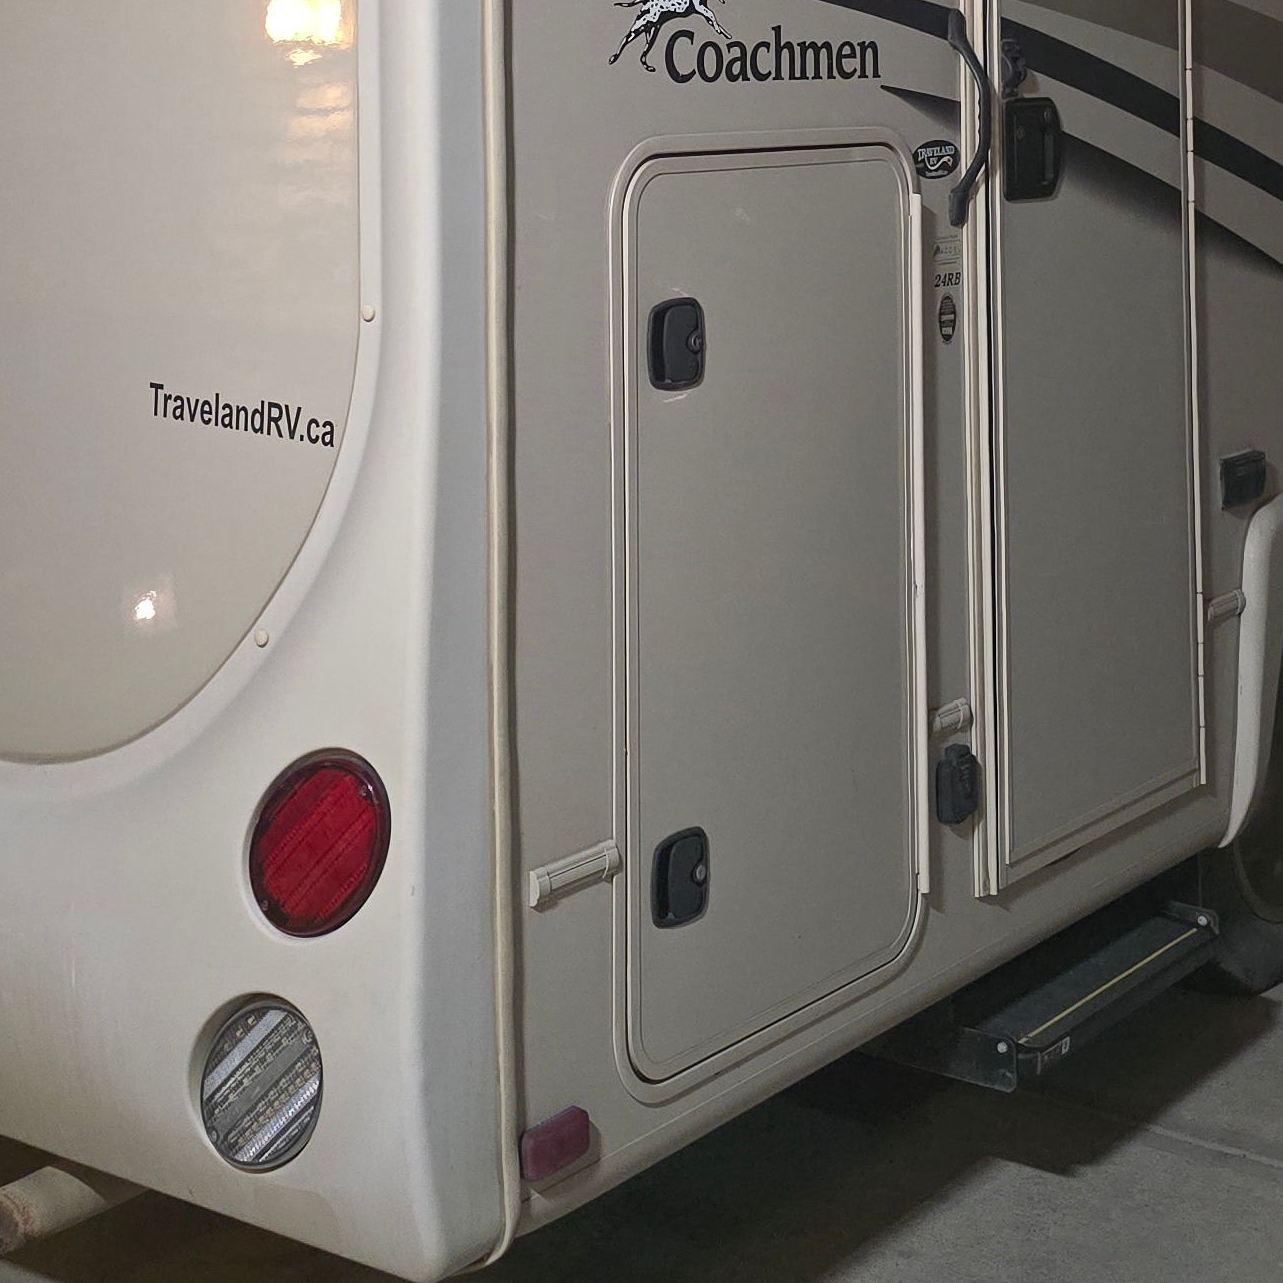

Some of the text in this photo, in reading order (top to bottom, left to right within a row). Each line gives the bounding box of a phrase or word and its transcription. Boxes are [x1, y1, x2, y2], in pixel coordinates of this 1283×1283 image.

[665, 25, 881, 83] Coachmen
[917, 146, 955, 161] TRAVELAND
[934, 272, 961, 288] 24RB
[149, 382, 335, 447] TravelandRV.ca
